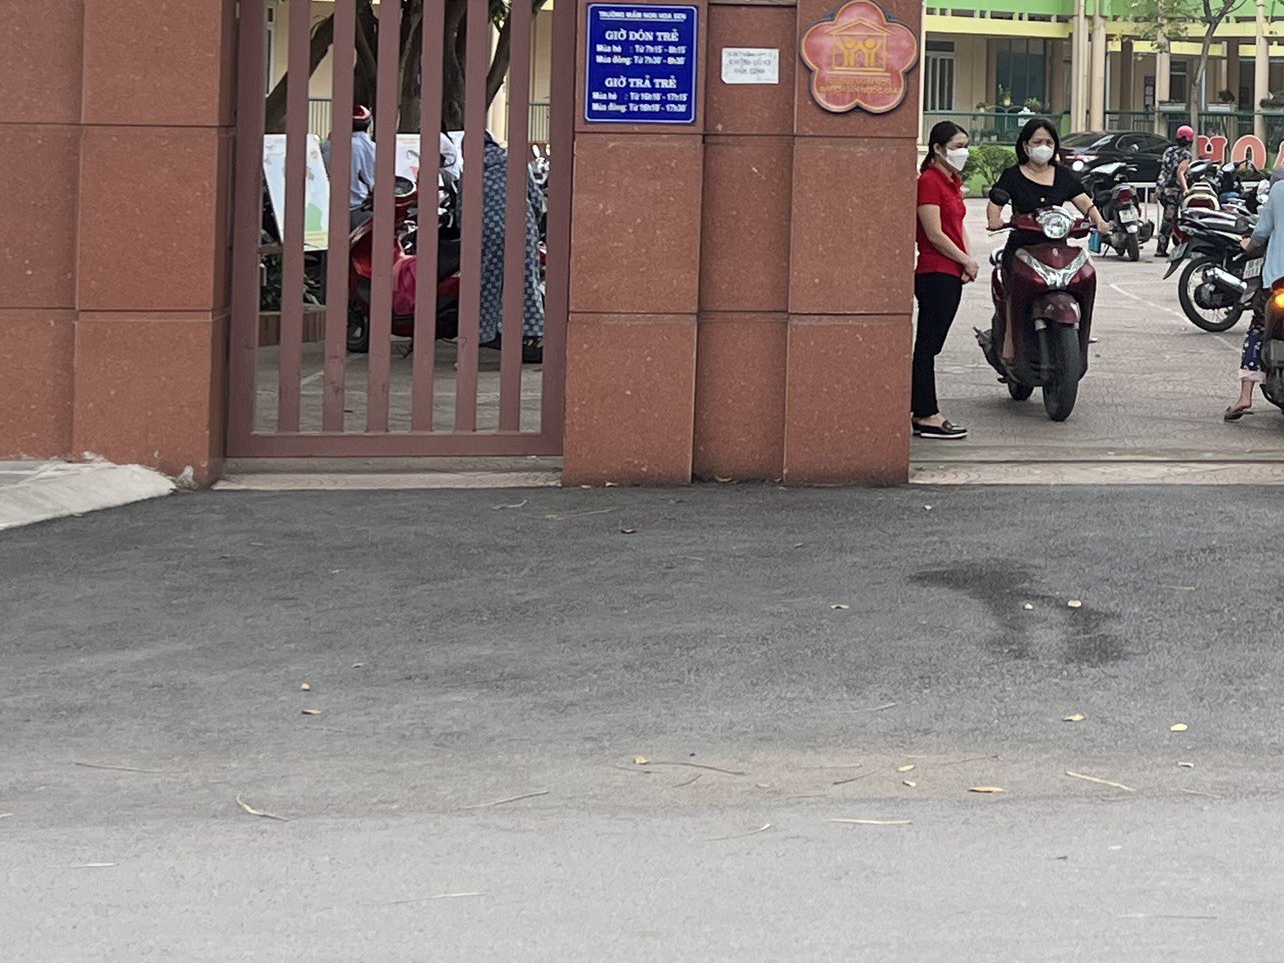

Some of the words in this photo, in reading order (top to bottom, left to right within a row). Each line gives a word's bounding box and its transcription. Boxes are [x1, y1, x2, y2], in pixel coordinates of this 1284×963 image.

[605, 28, 627, 41] GIỜ
[629, 29, 654, 42] ĐÓN
[655, 28, 680, 42] TRẺ
[604, 75, 627, 88] GIỜ
[628, 74, 652, 88] TRẢ
[653, 74, 677, 89] TRẺ
